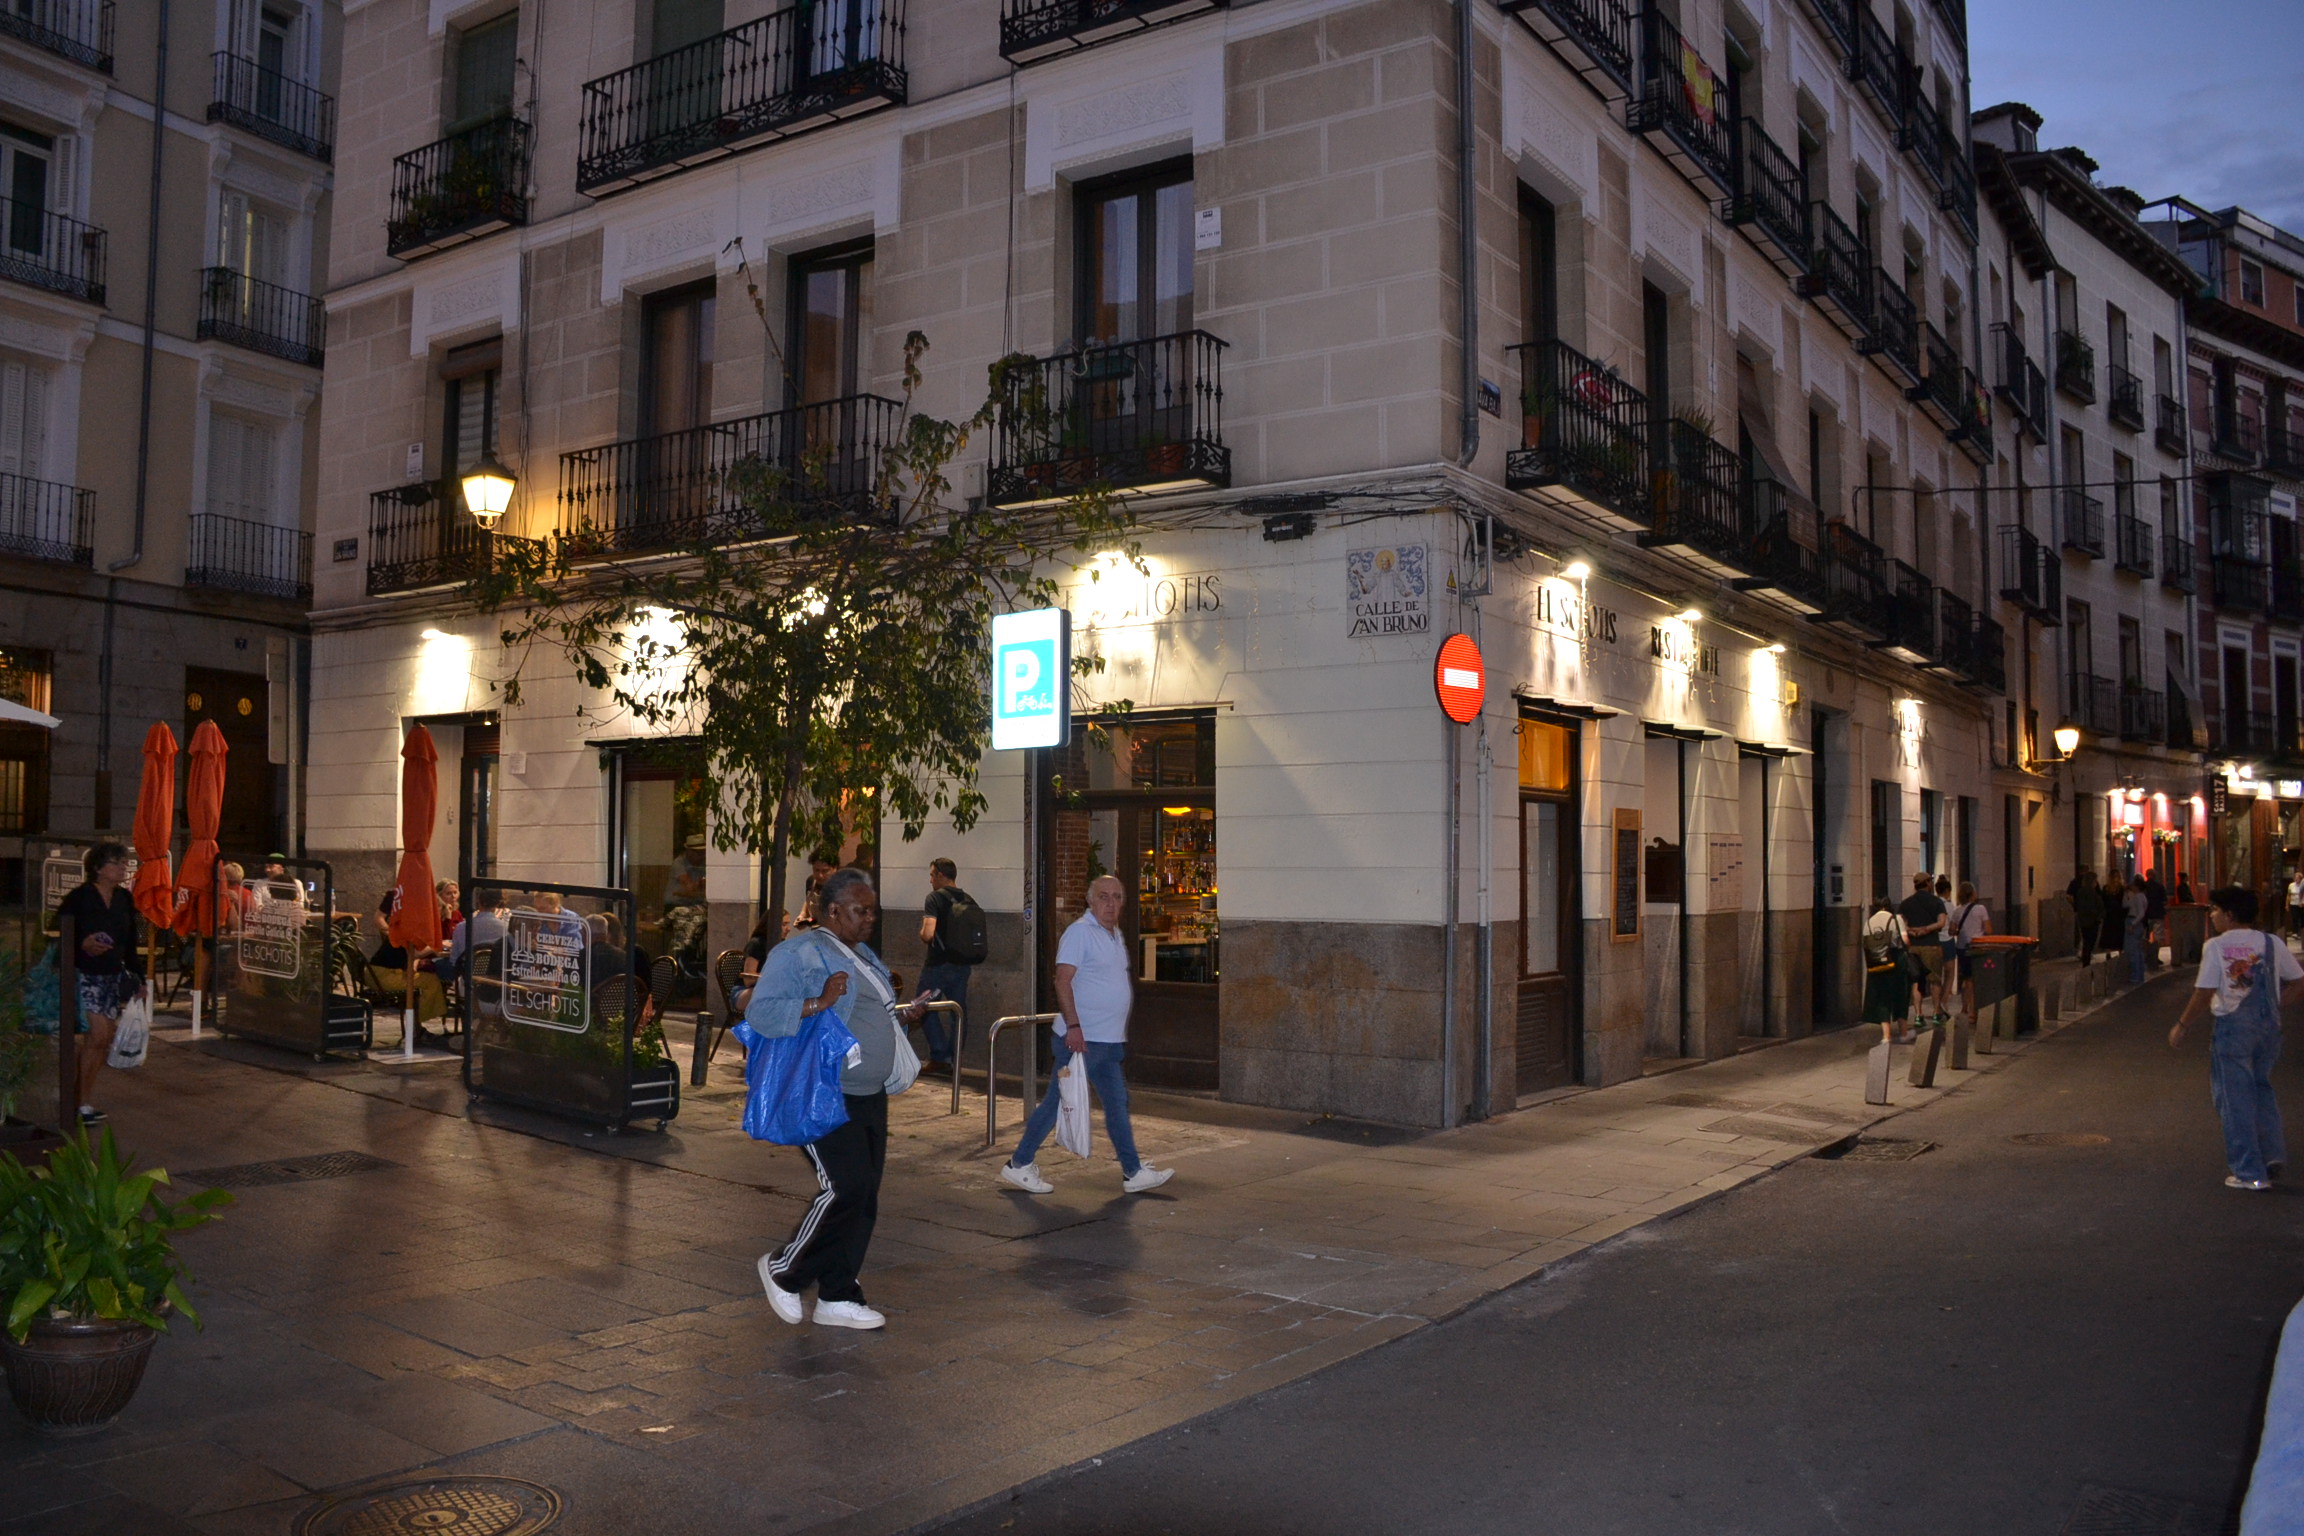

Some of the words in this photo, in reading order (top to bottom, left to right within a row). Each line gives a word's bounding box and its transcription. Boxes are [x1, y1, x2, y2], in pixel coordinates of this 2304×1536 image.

[1356, 601, 1402, 617] CALLE
[1405, 601, 1419, 612] DE
[1347, 617, 1379, 637] SAN
[1383, 613, 1427, 633] BRUNO
[1004, 649, 1040, 713] P
[2213, 779, 2225, 793] 17
[536, 932, 579, 948] CERVEZA
[243, 943, 253, 959] EL
[255, 945, 292, 965] SCHOTIS
[536, 952, 580, 970] BODEGA
[511, 962, 540, 981] Estrella
[541, 966, 569, 984] Galicia
[510, 988, 523, 1007] EL
[526, 990, 580, 1017] SCHOTIS
